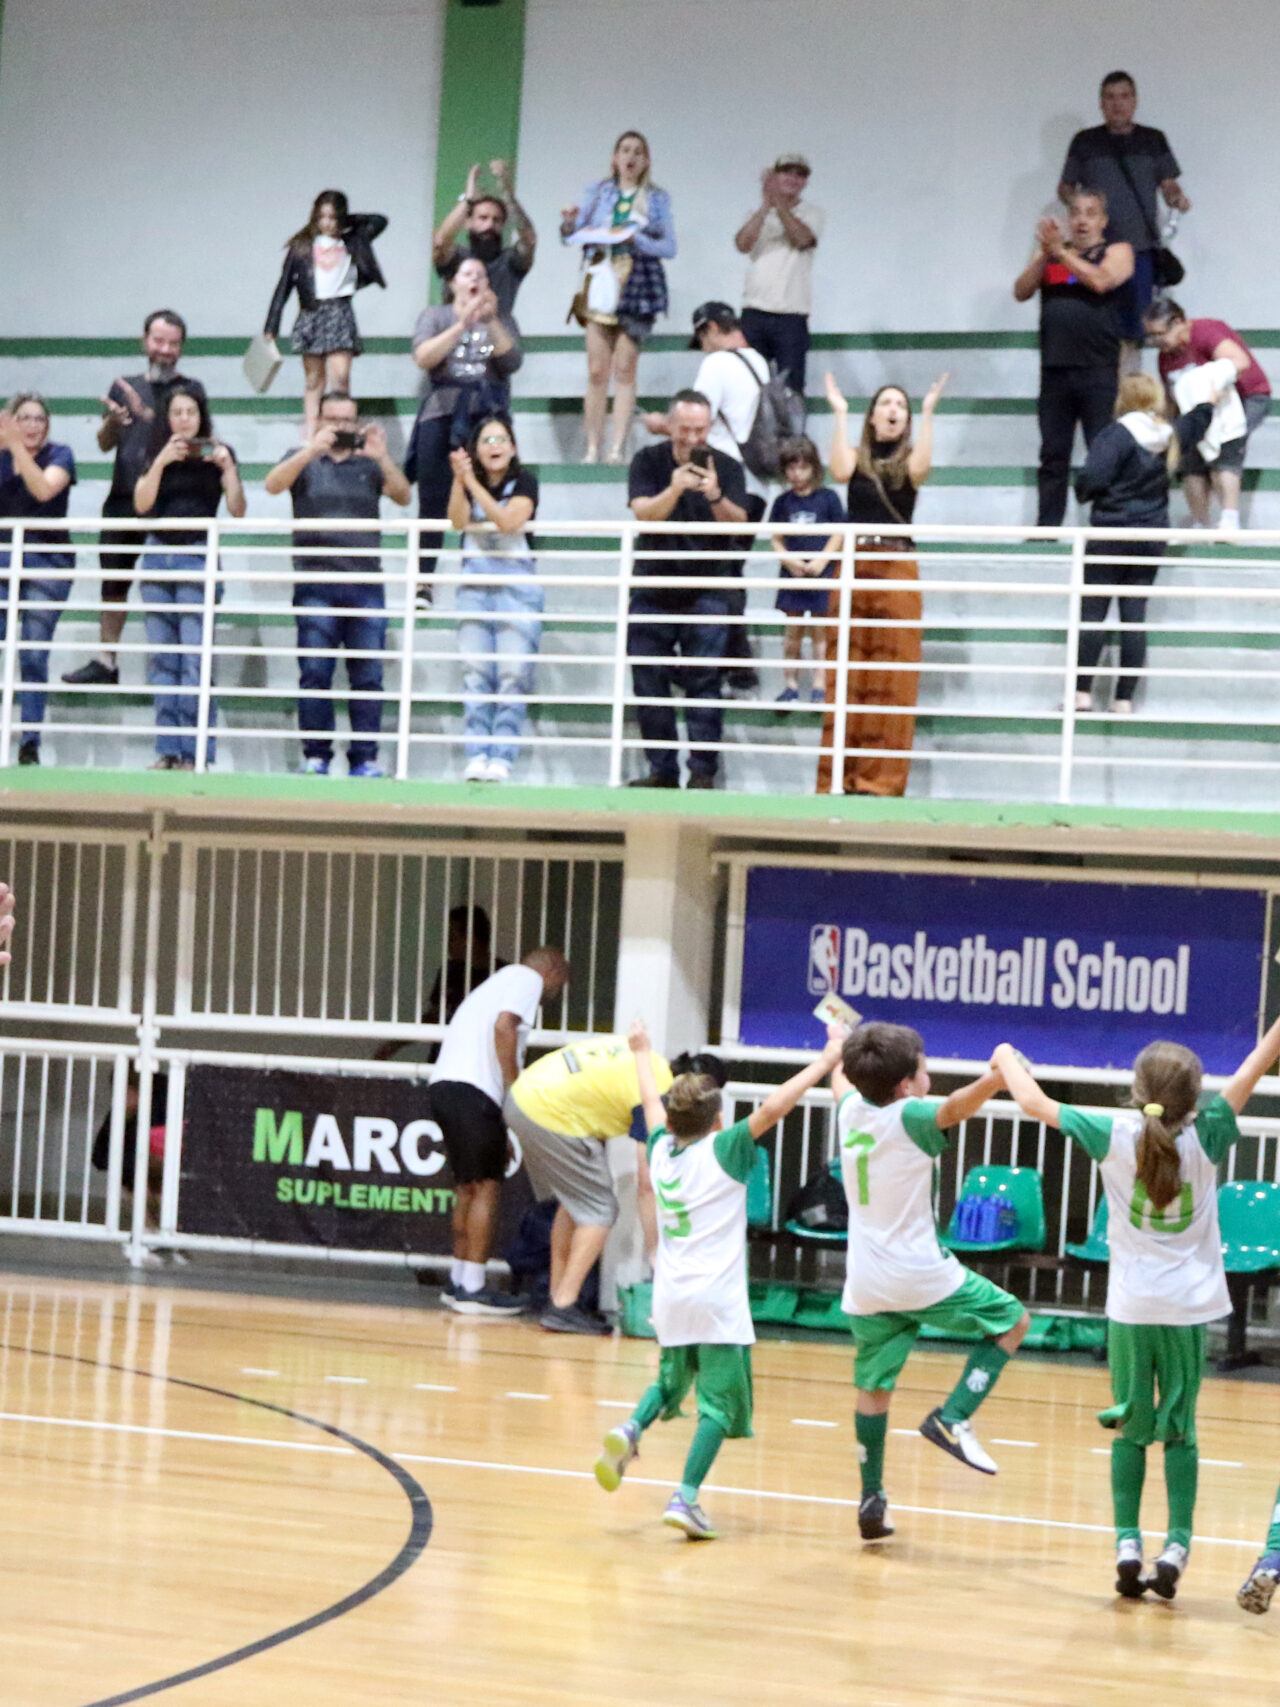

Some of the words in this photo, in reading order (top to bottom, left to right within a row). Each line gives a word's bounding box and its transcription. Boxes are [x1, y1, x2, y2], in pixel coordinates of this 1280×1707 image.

[842, 927, 1047, 1007] Basketball
[1051, 938, 1190, 1014] School
[276, 1177, 457, 1215] SUPLEMENT
[656, 1176, 692, 1239] 5
